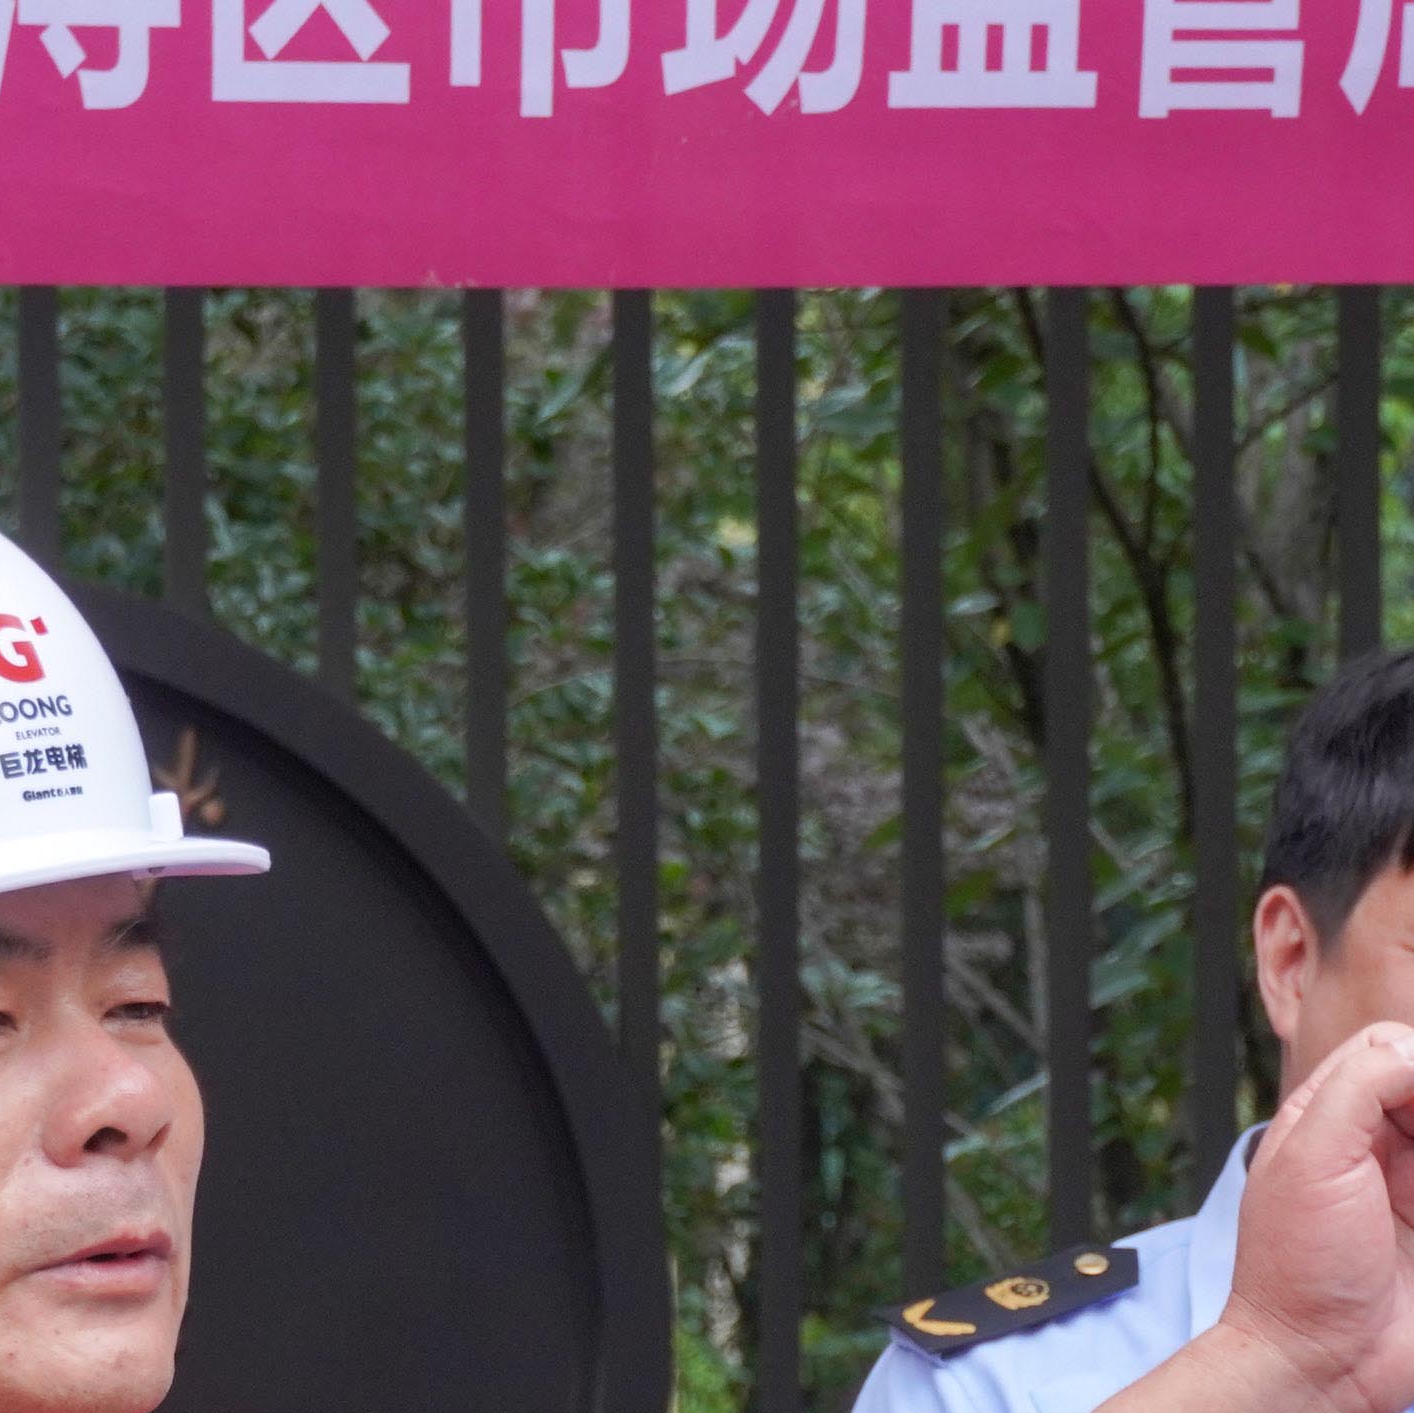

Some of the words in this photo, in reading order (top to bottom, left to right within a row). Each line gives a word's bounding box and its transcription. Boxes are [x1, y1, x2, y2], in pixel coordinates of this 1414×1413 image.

[15, 727, 62, 741] ELEVATOR
[0, 744, 87, 779] 巨龙电梯
